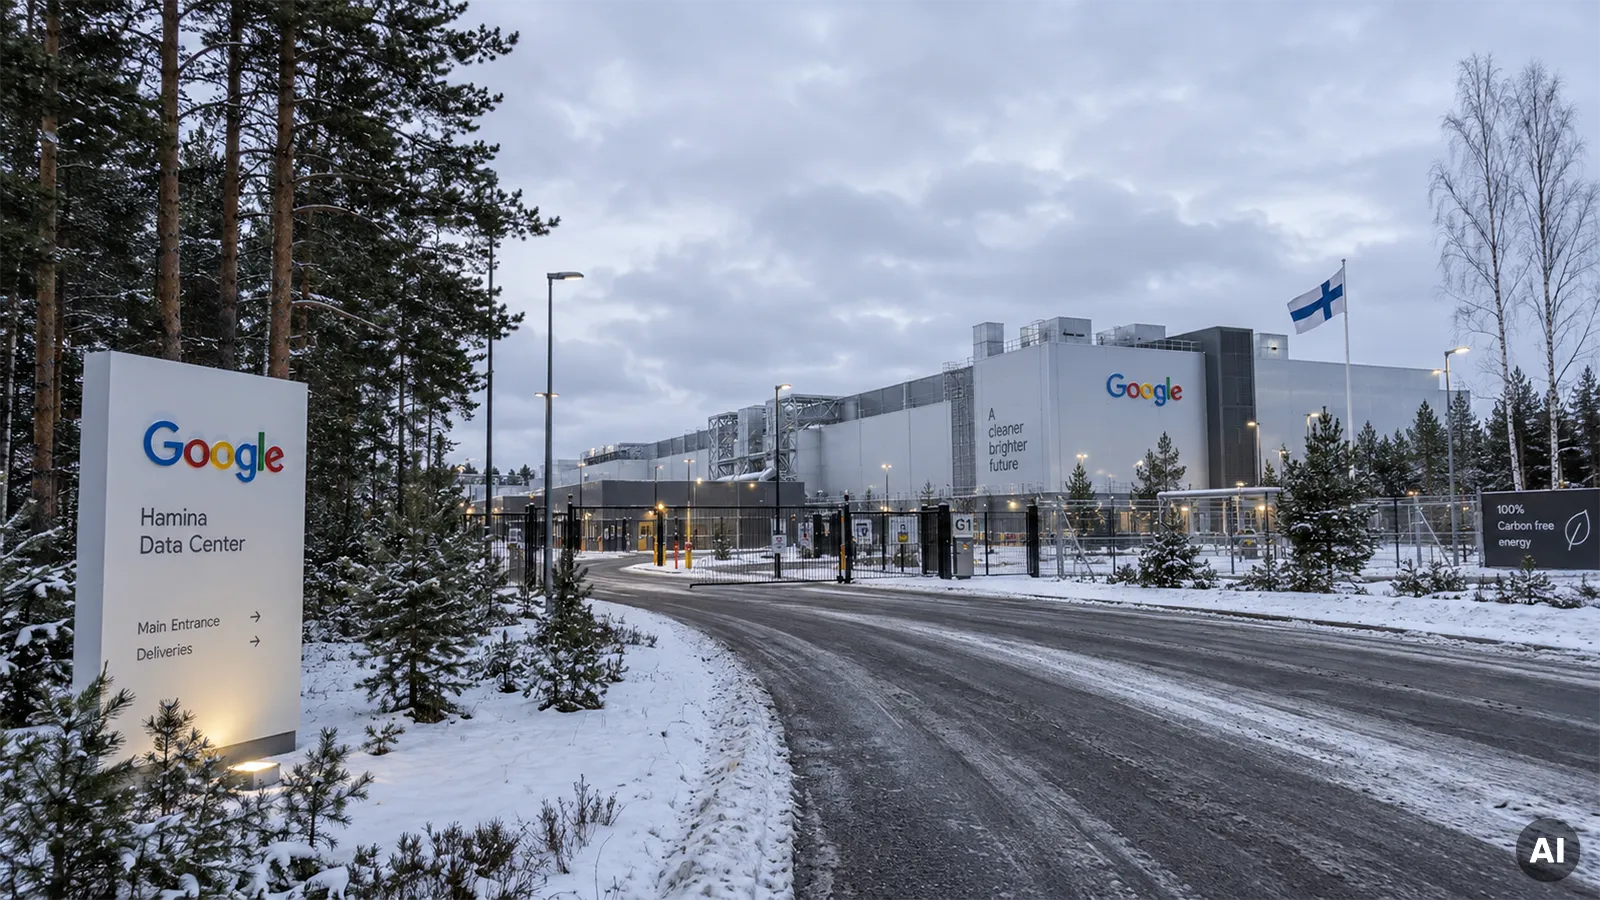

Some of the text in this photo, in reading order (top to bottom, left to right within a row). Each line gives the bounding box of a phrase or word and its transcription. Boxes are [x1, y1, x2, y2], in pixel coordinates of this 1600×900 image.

[1106, 373, 1183, 407] Google
[988, 408, 996, 421] A
[988, 422, 1024, 438] cleaner
[143, 420, 284, 483] Google
[988, 439, 1028, 457] brighter
[989, 458, 1019, 472] future
[141, 507, 207, 527] Hamina
[1497, 504, 1525, 514] 100%
[955, 518, 972, 531] G1
[1497, 520, 1555, 531] Carbon free
[140, 534, 246, 555] Data Center
[1498, 538, 1531, 549] energy
[137, 616, 220, 635] Main Entrance
[137, 644, 193, 661] Deliveries
